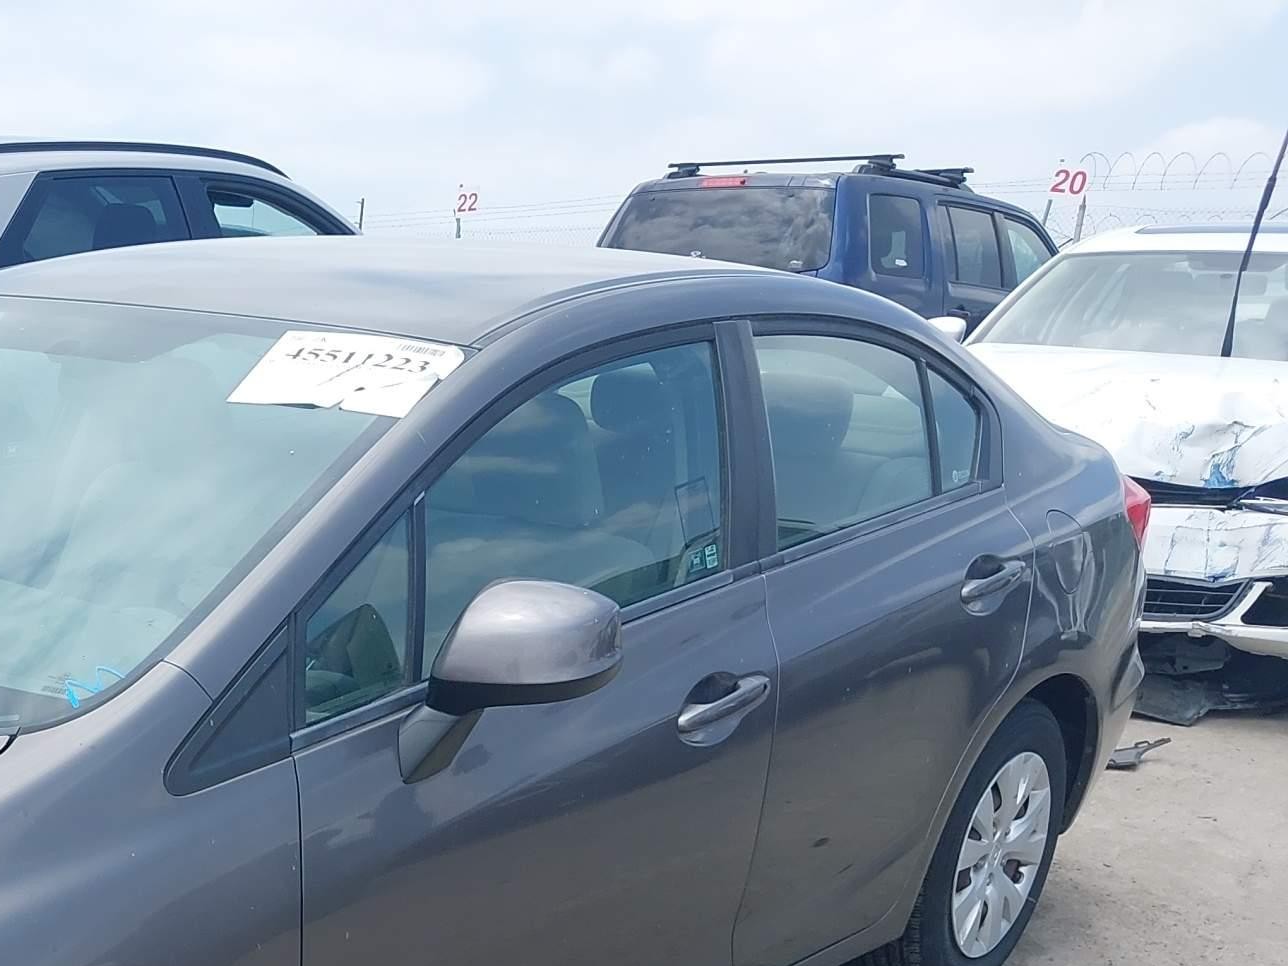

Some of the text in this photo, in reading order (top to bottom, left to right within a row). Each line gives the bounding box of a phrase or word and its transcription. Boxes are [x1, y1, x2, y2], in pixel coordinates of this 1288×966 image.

[1050, 169, 1087, 195] 20
[457, 193, 478, 212] 22
[285, 347, 430, 373] 45511223
